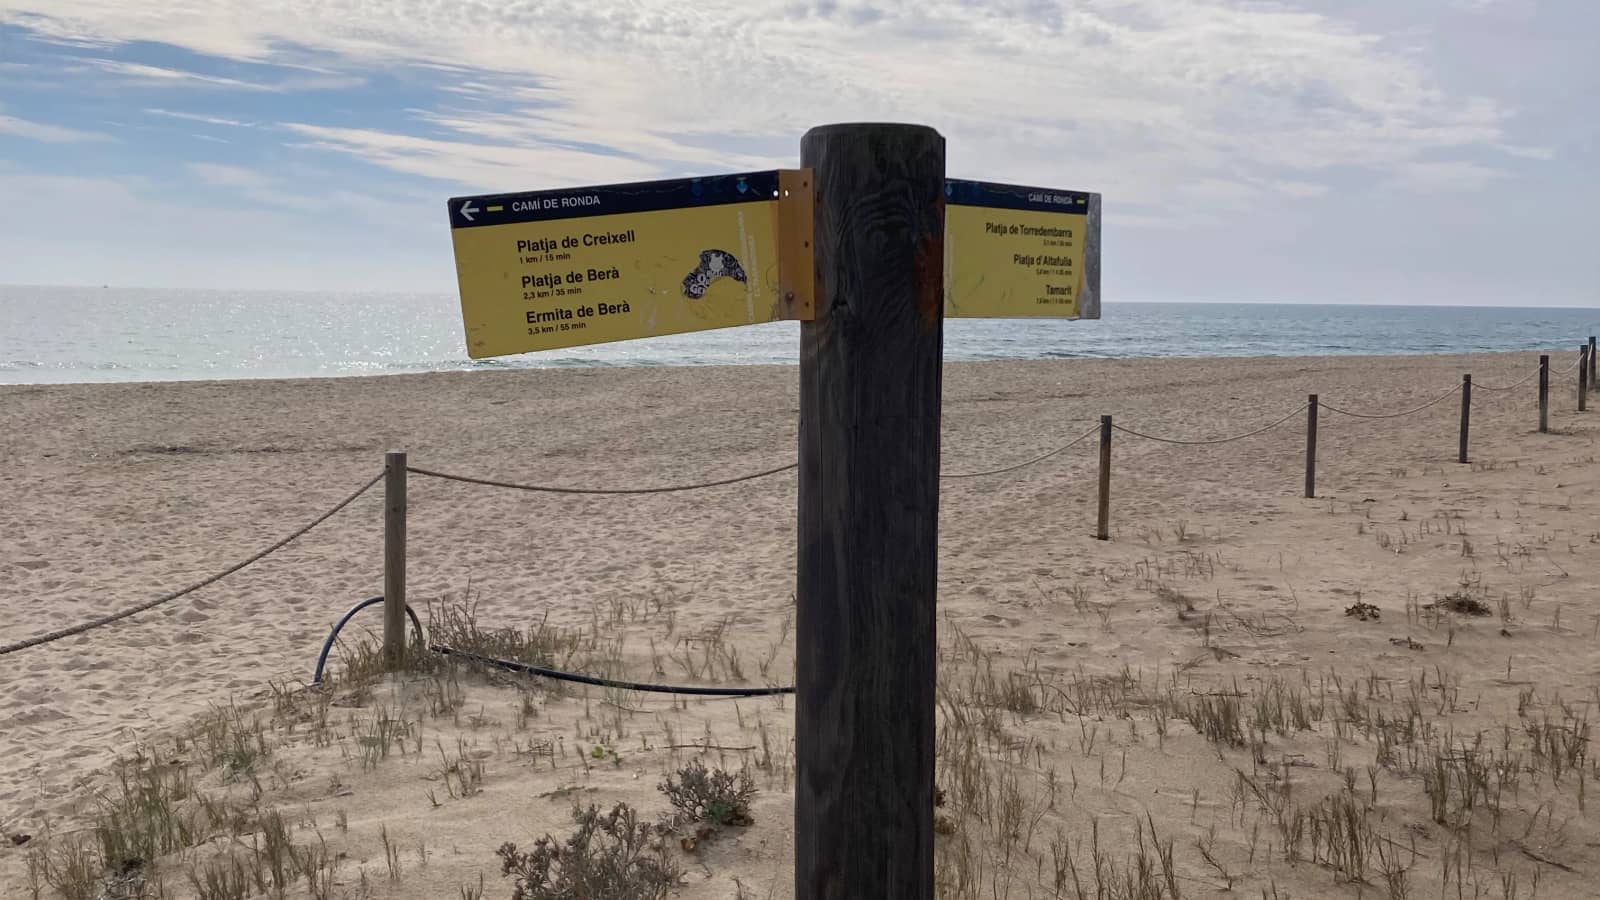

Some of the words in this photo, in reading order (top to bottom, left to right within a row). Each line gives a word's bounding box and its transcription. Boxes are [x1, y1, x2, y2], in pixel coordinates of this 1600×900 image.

[512, 198, 540, 212] CAMÍ
[544, 198, 559, 209] DE
[562, 195, 601, 208] RONDA
[1044, 193, 1052, 203] DE
[985, 222, 1007, 236] Platja
[1009, 224, 1019, 234] de
[1020, 224, 1072, 238] Torredembarra
[517, 238, 557, 253] Platja
[561, 235, 579, 249] de
[583, 229, 635, 247] Creixell
[545, 254, 554, 262] 15
[555, 253, 571, 261] min
[1013, 254, 1034, 268] Platja
[522, 273, 562, 288] Platja
[566, 271, 583, 284] de
[587, 267, 620, 281] Berà
[523, 291, 536, 300] 2,3
[537, 290, 549, 298] km
[555, 288, 565, 296] 35
[567, 287, 582, 295] min
[1046, 285, 1072, 296] Tamarit
[526, 308, 572, 324] Ermita
[577, 305, 594, 318] de
[598, 301, 630, 316] Berà
[528, 327, 540, 335] 3,5
[541, 324, 554, 333] km
[560, 323, 570, 331] 55
[571, 321, 587, 330] min
